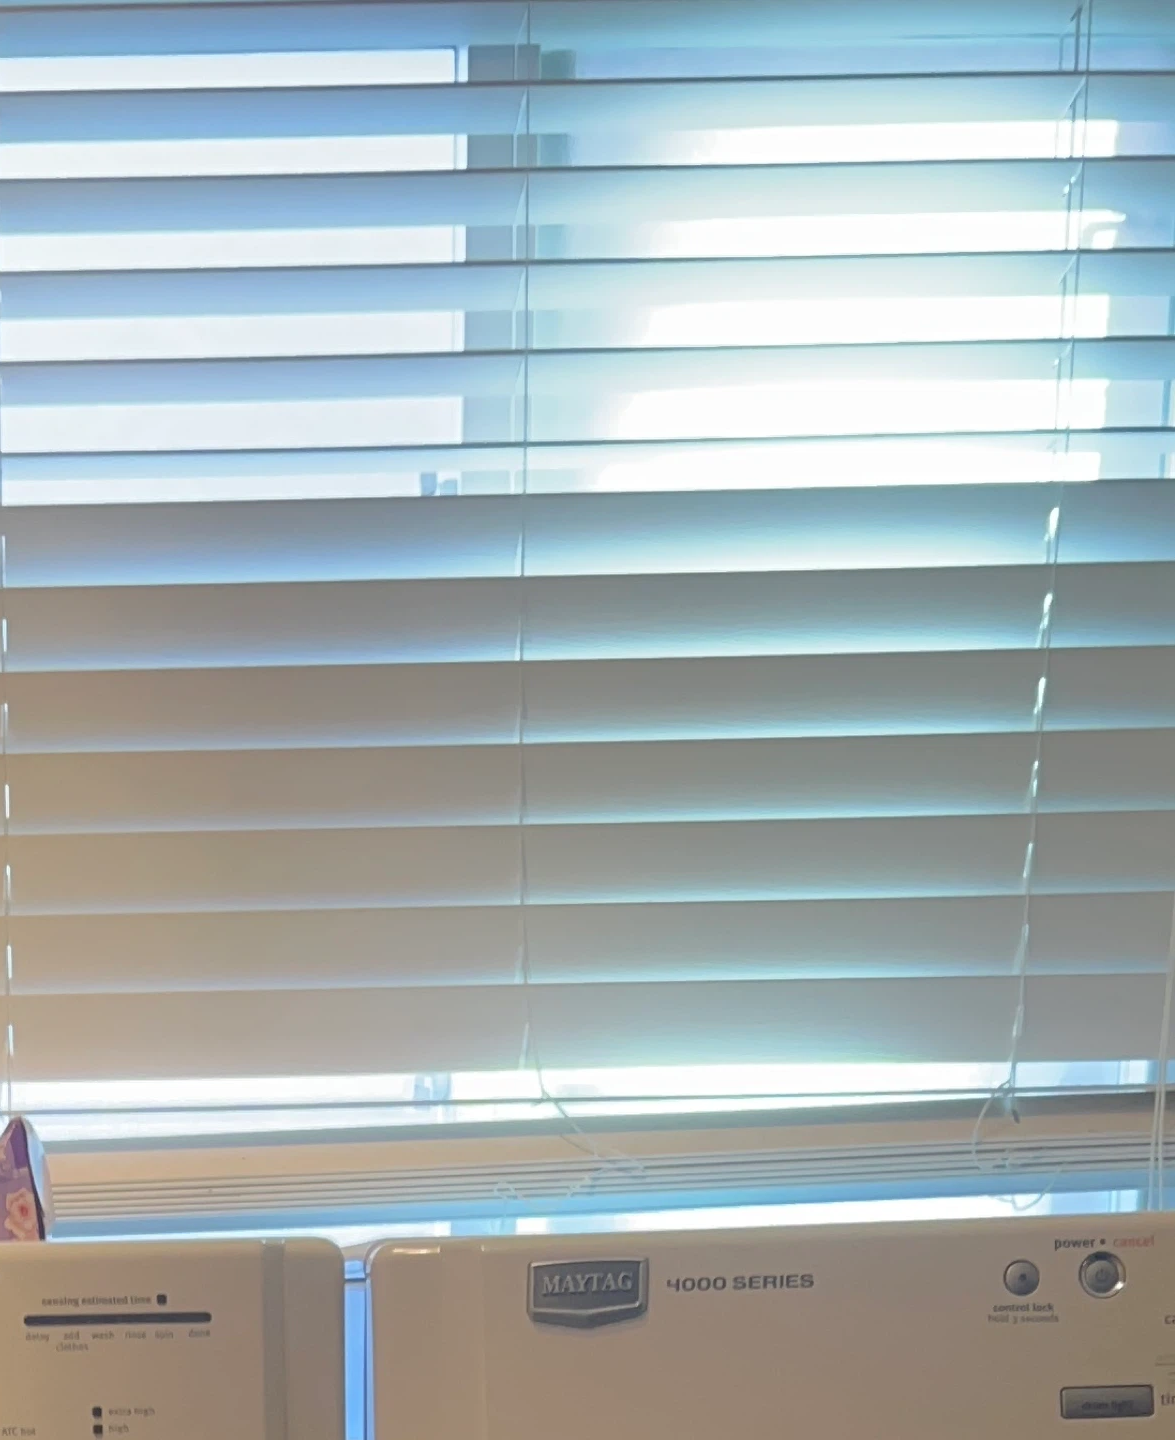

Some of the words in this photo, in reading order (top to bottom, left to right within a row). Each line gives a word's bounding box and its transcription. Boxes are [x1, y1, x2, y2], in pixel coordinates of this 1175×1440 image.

[1054, 1237, 1095, 1251] power
[1113, 1235, 1155, 1248] cancel
[541, 1271, 633, 1295] MAYTAG
[666, 1276, 727, 1292] 4000
[732, 1274, 815, 1291] SERIES
[993, 1303, 1029, 1313] control
[1032, 1302, 1054, 1312] lock
